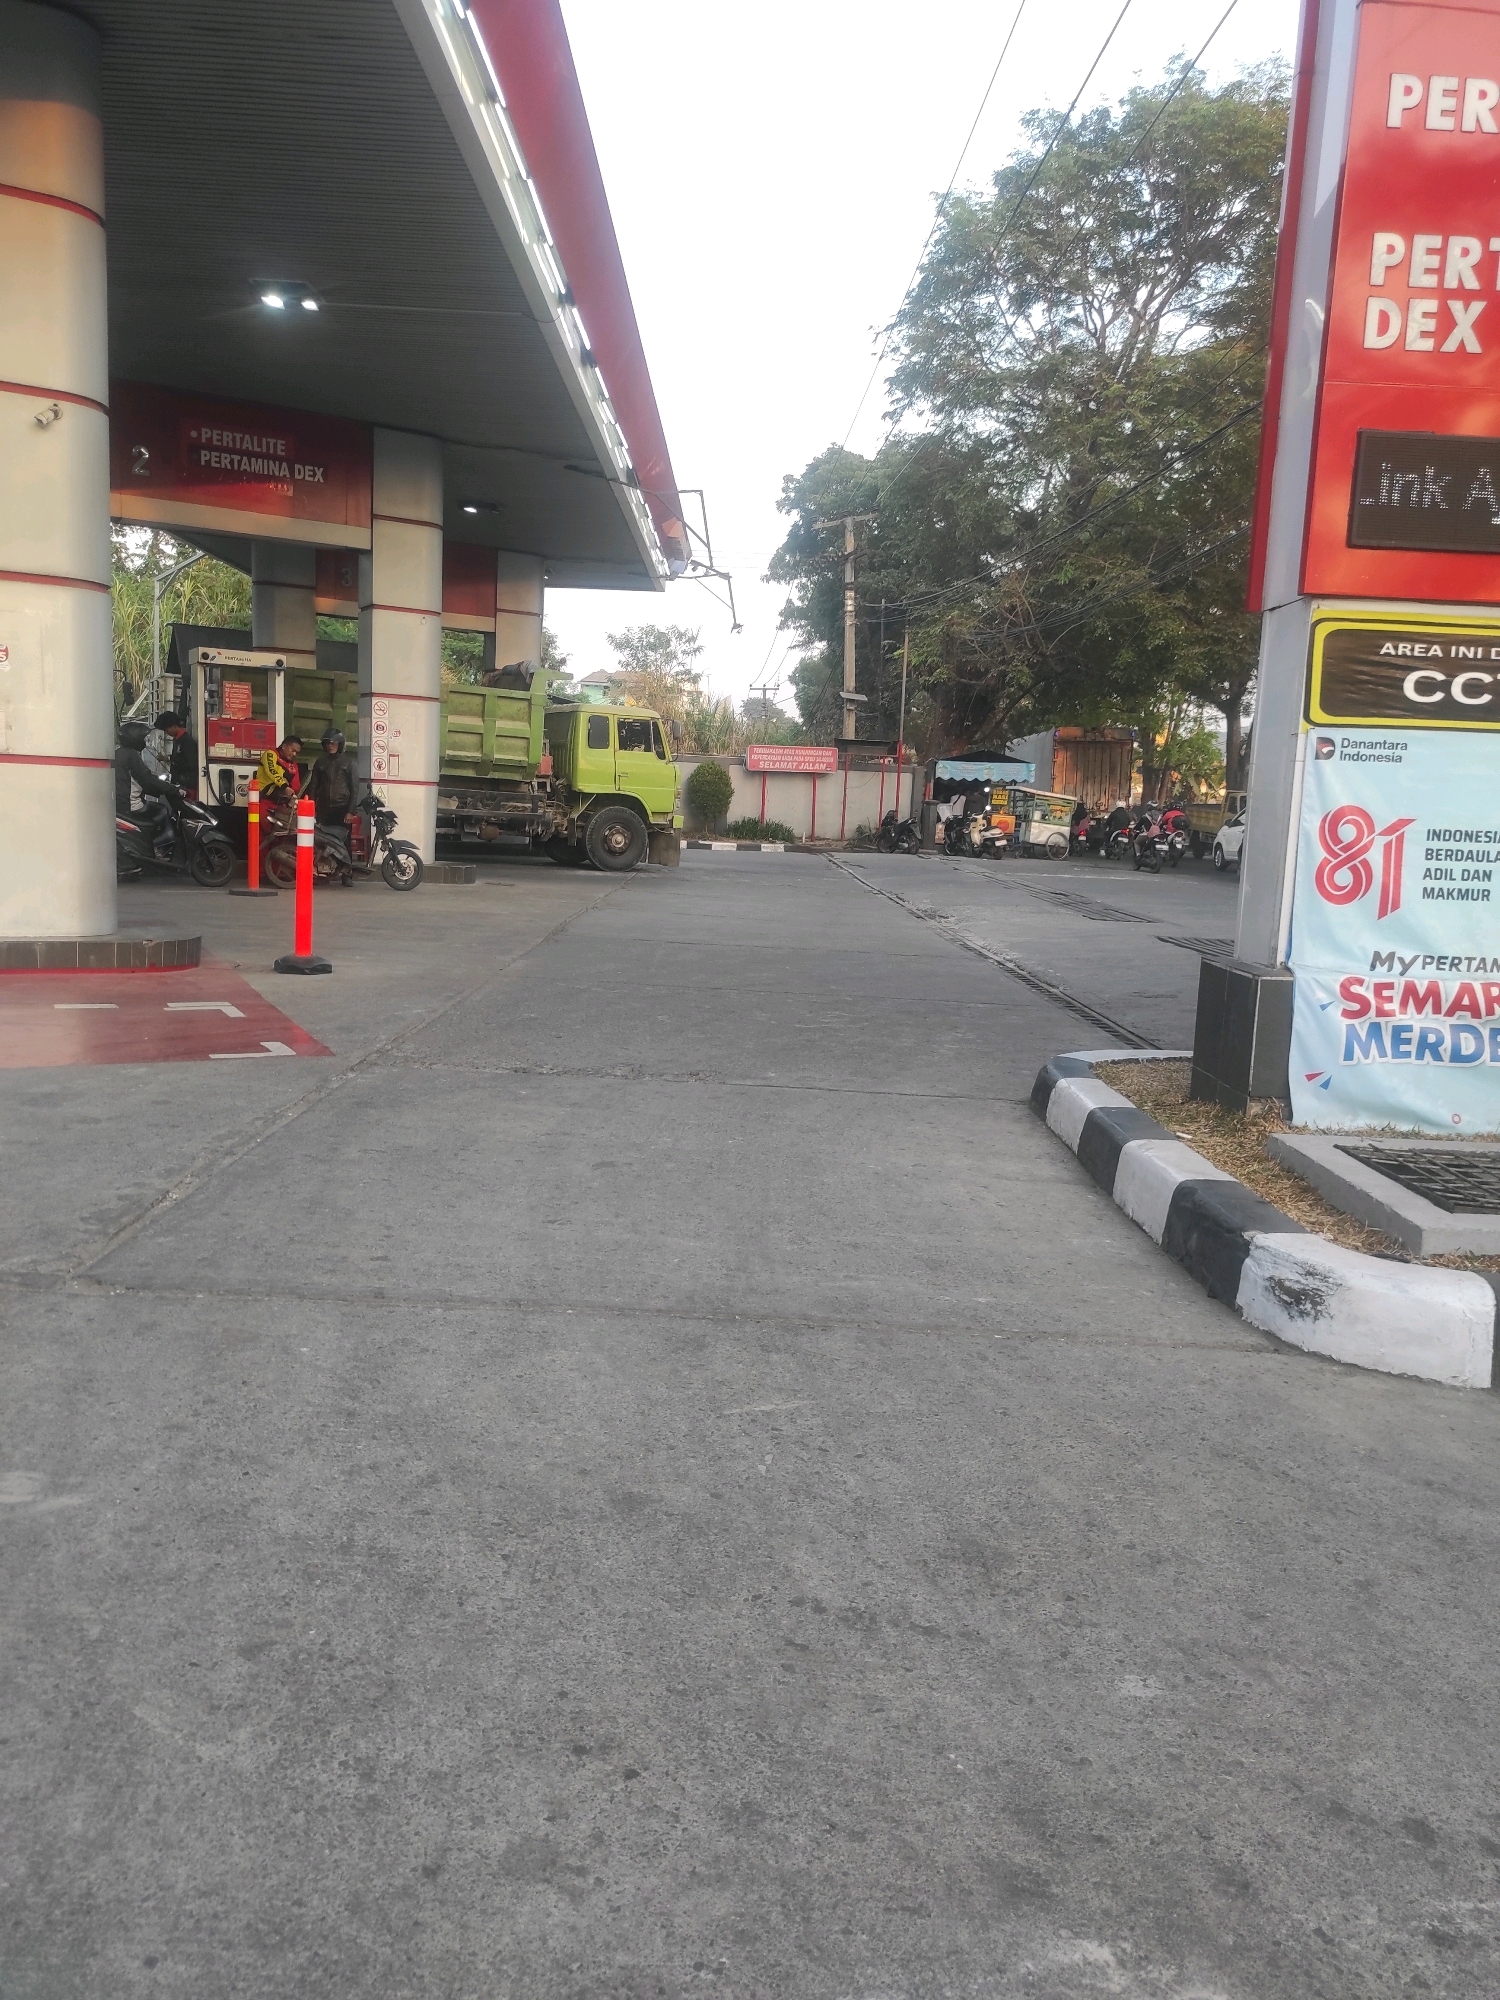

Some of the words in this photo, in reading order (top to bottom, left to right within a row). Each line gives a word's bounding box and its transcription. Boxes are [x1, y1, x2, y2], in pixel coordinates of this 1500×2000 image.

[1386, 73, 1500, 133] PER
[1363, 296, 1487, 354] DEX
[201, 428, 286, 455] PERTALITE
[131, 445, 151, 476] 2
[200, 450, 290, 478] PERTAMINA
[294, 464, 324, 483] DEX
[1360, 463, 1452, 509] ink
[1462, 468, 1500, 524] A
[341, 568, 352, 587] 3
[1379, 643, 1443, 657] AREA
[1450, 645, 1483, 659] INI
[1403, 670, 1500, 705] CC
[1341, 738, 1408, 751] Danantara
[759, 760, 797, 769] SELAMAT
[799, 762, 826, 770] JALAN
[1339, 751, 1402, 764] Indonesia
[1426, 828, 1500, 844] INDONESI
[1315, 805, 1417, 920] 81
[1423, 867, 1456, 881] ADIL
[1461, 868, 1492, 882] DAN
[1422, 886, 1491, 902] MAKMUR
